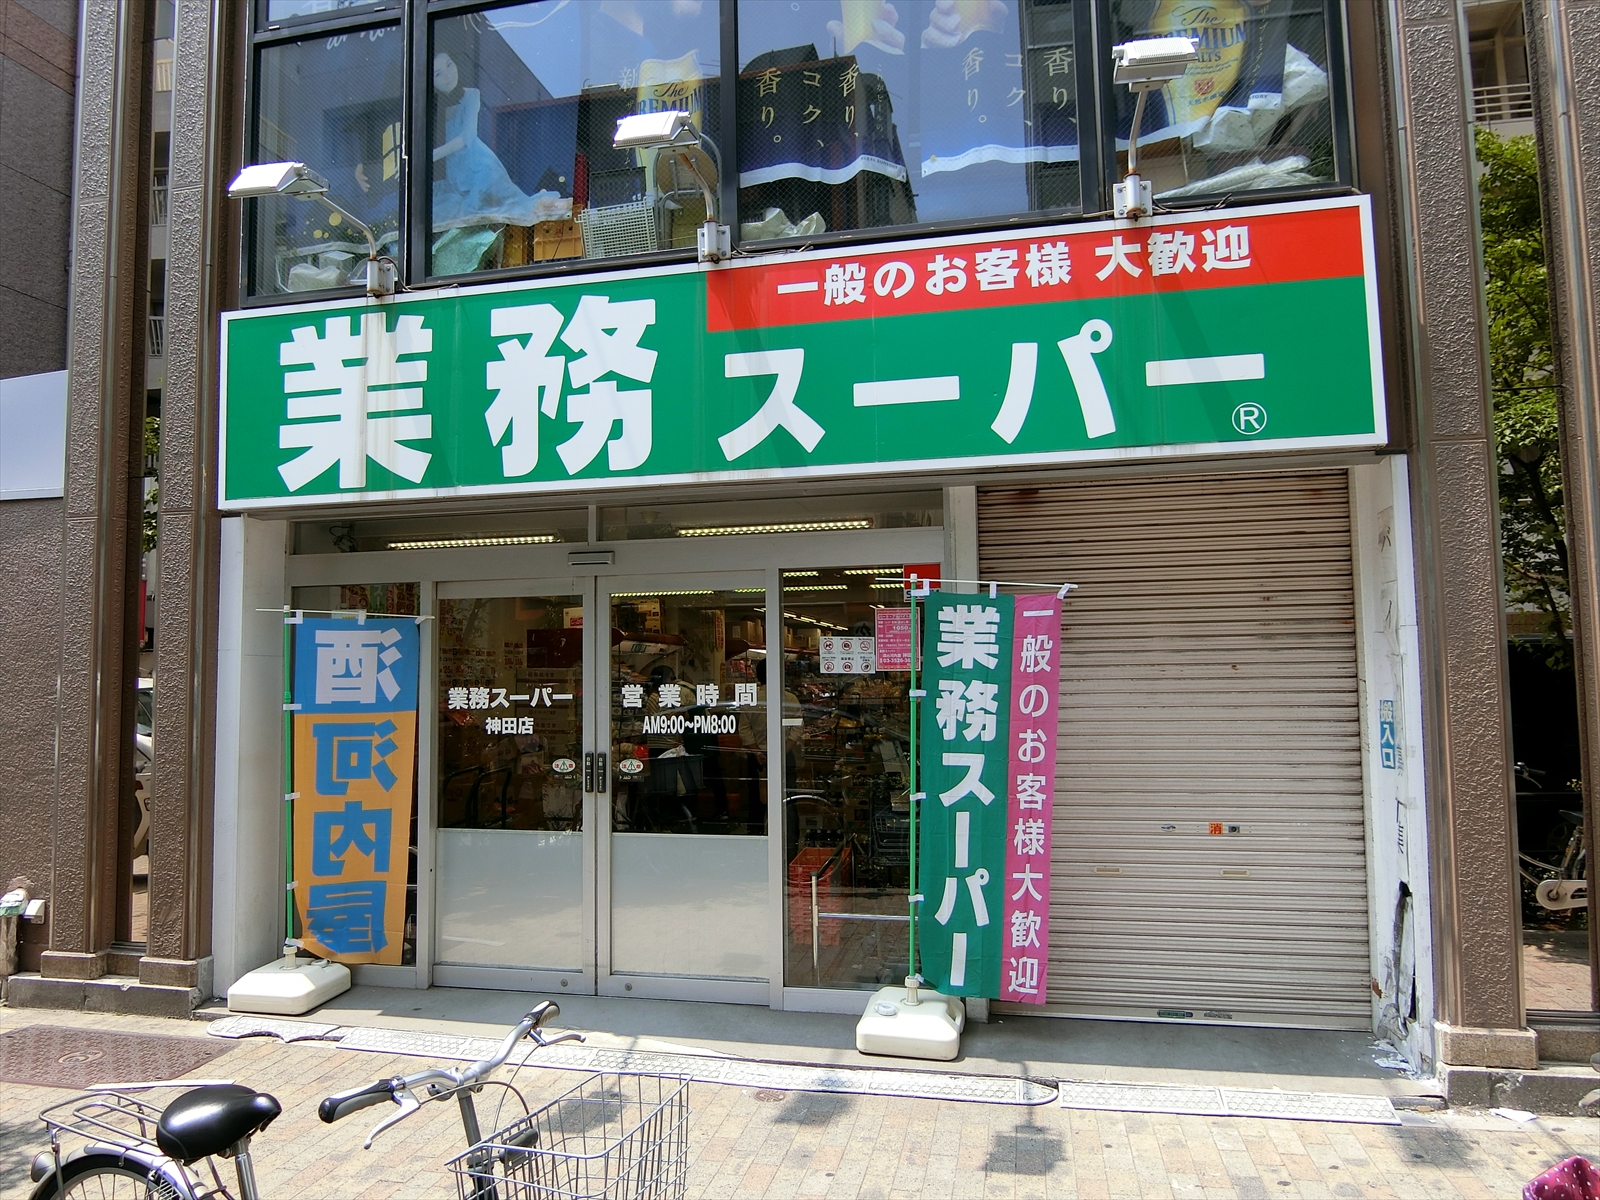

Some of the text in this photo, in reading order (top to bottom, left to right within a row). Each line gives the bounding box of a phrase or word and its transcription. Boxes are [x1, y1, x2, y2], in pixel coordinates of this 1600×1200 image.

[1172, 6, 1226, 26] The
[755, 67, 782, 143] 香り。
[802, 70, 825, 148] コク、
[839, 63, 859, 137] 香り、
[961, 46, 987, 124] 香り。
[776, 225, 1253, 306] 一般のお客様 大歓迎
[277, 295, 1265, 493] 業務スーパー
[448, 686, 573, 710] 業務スーパー
[485, 716, 534, 735] 神田店
[621, 683, 758, 709] 営業時間
[934, 604, 1000, 987] 業務スーパー
[1008, 609, 1054, 996] 一般のお客様大歓迎
[1210, 822, 1222, 835] 消
